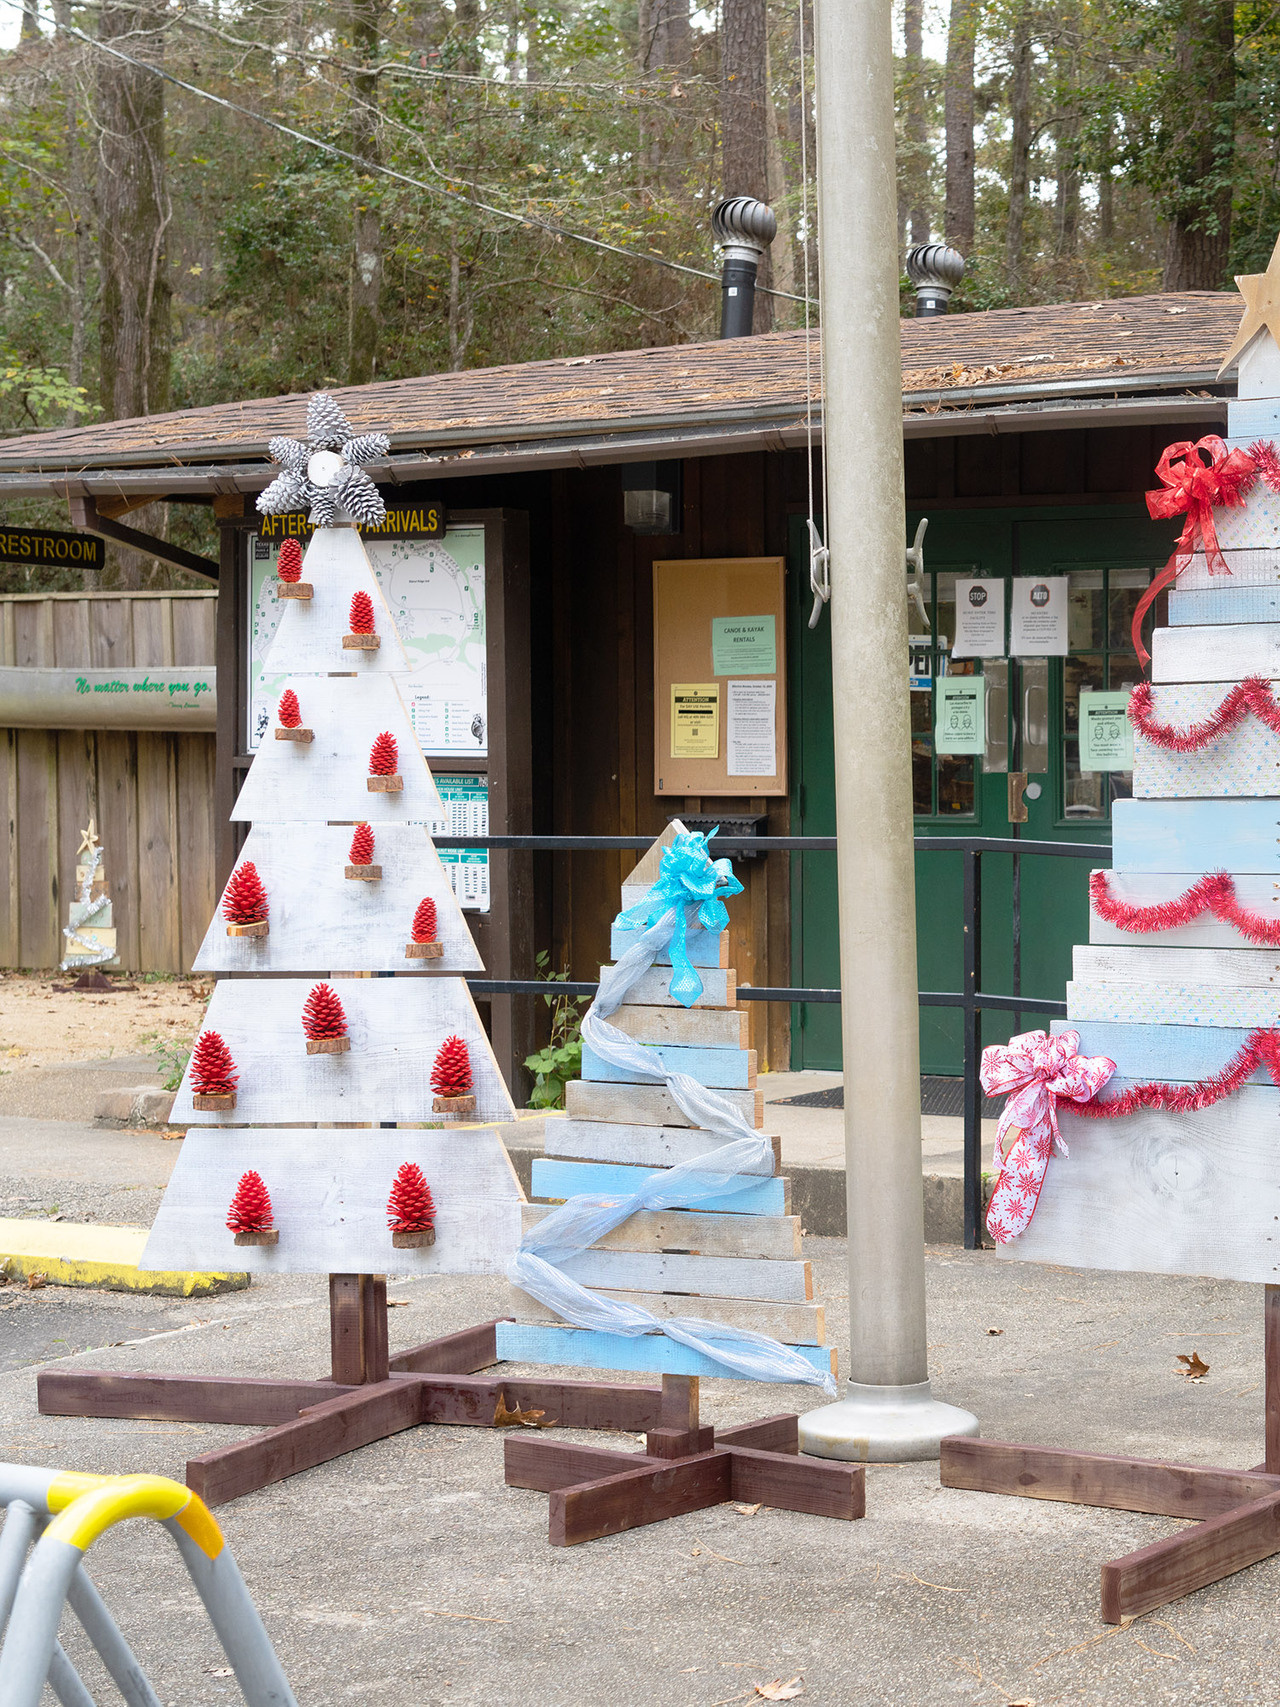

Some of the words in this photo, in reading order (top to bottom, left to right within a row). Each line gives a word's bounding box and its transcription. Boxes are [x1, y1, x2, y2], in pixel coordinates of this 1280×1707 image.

[0, 533, 97, 562] RESTROOM
[970, 592, 987, 601] STOP
[1032, 591, 1048, 600] ALTO
[75, 677, 91, 694] No
[94, 680, 129, 693] matter
[133, 676, 165, 693] where
[168, 682, 190, 697] you
[439, 777, 463, 785] AVAILABLE
